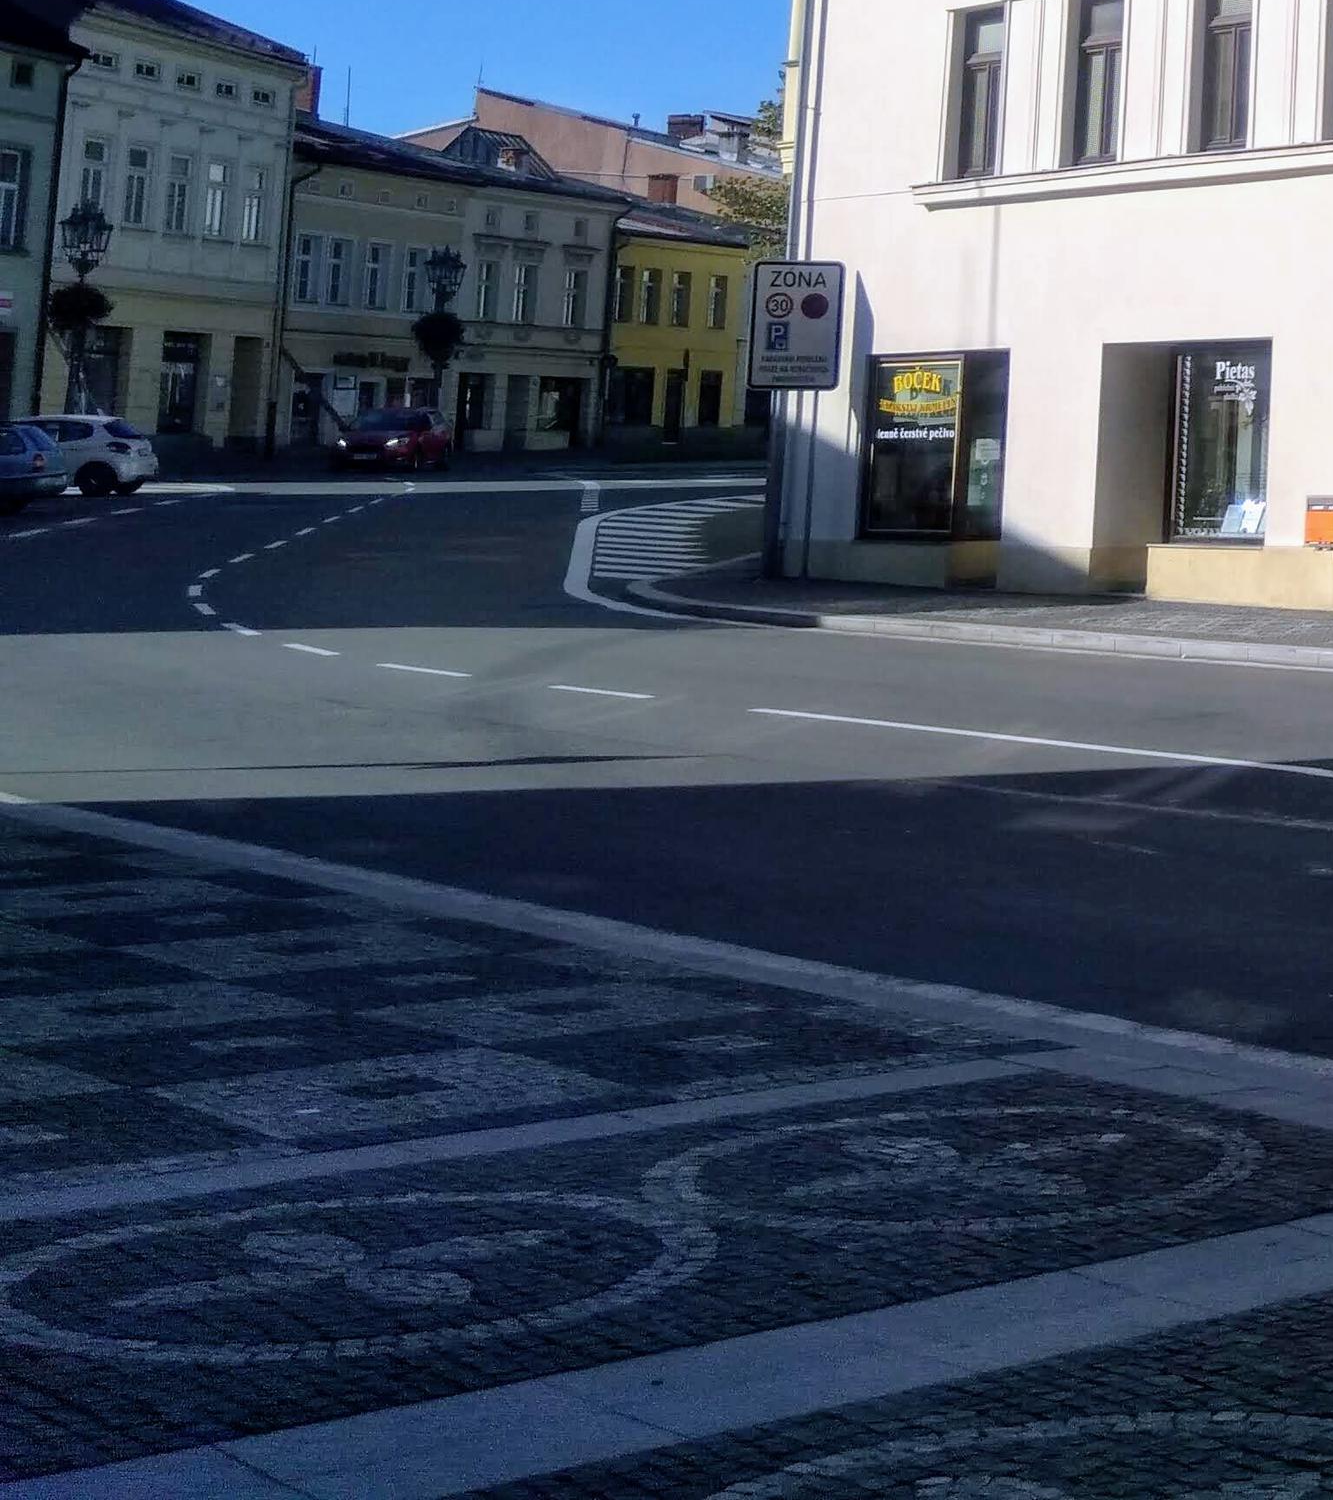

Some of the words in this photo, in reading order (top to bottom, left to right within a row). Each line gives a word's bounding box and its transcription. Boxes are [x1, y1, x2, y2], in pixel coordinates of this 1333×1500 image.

[769, 267, 827, 288] ZÓNA
[771, 299, 789, 312] 30
[894, 366, 941, 394] BOČEK
[1215, 361, 1255, 380] Pietas
[900, 427, 928, 439] čerstvé
[929, 427, 955, 440] pečivo
